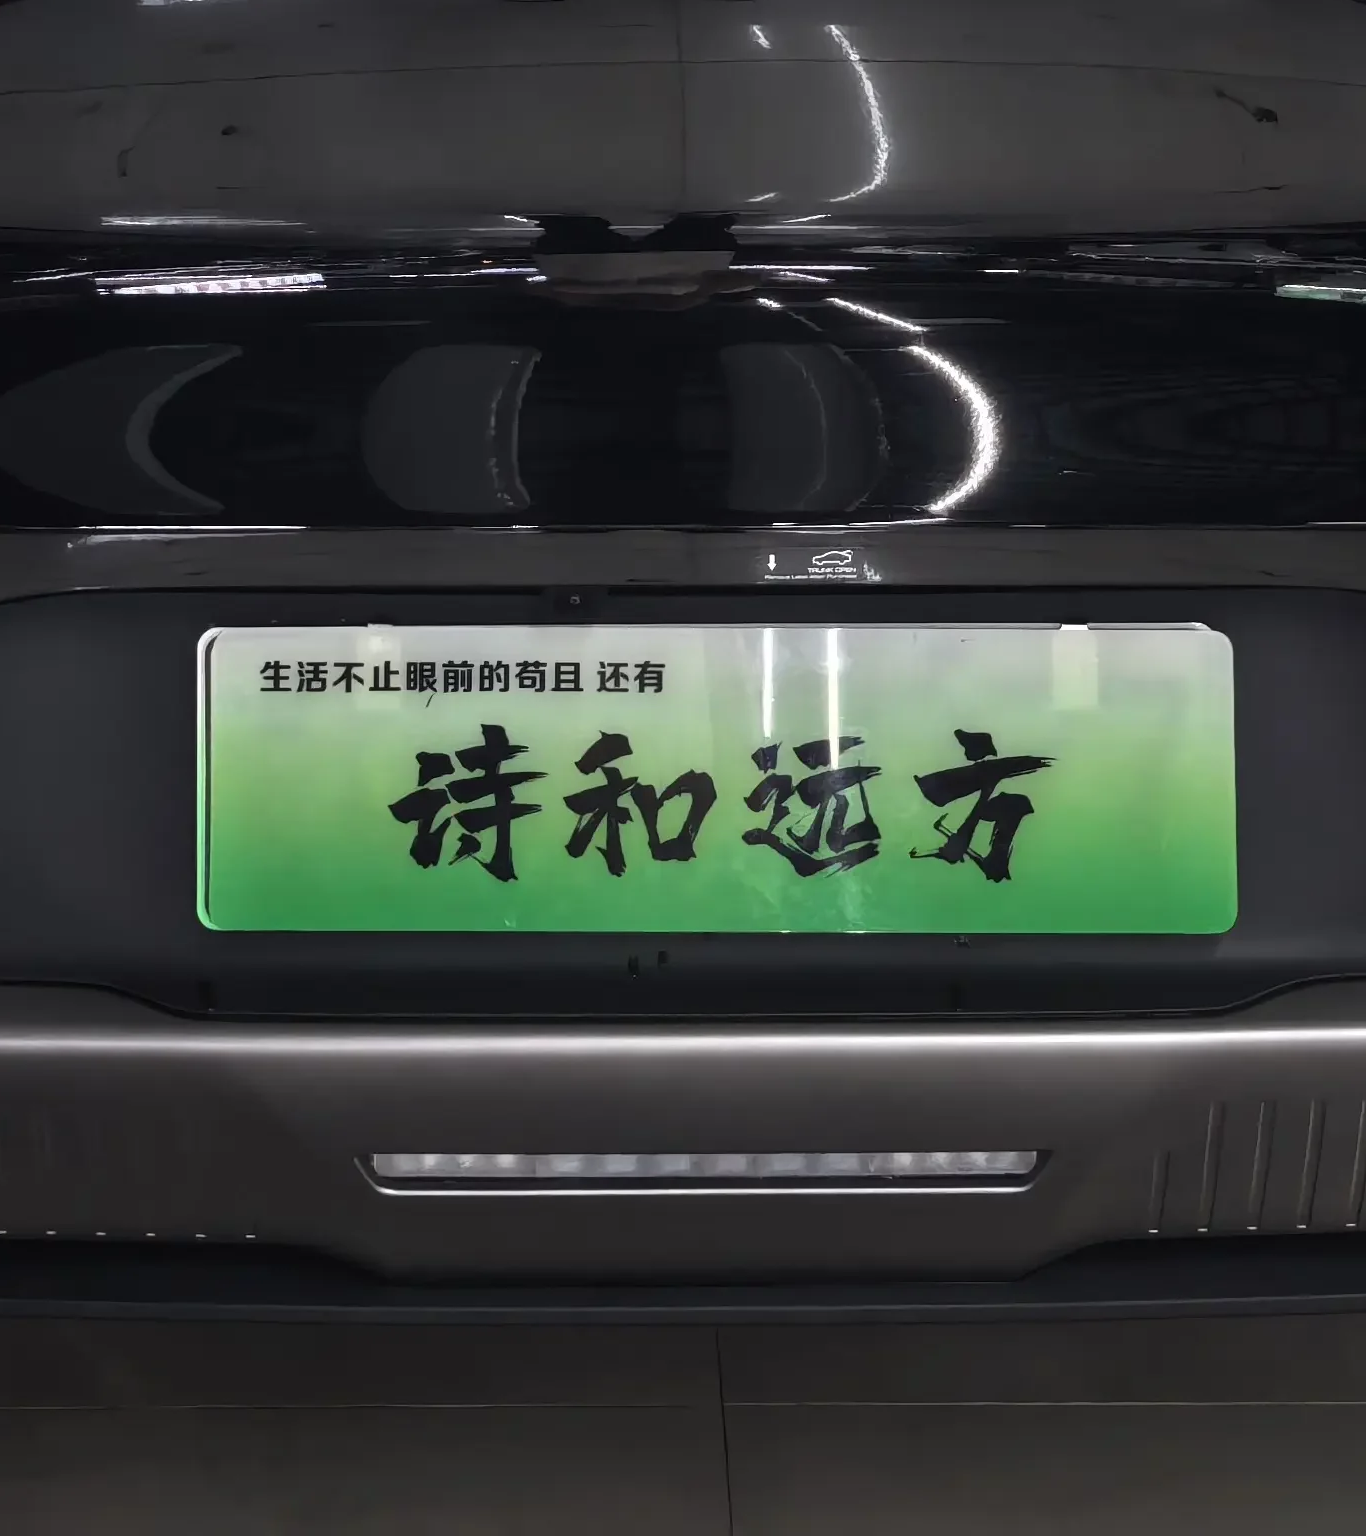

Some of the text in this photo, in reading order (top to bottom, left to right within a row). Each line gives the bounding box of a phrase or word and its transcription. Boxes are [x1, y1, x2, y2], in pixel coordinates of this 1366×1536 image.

[259, 661, 666, 693] 生活不止眼前的苟且 还有
[388, 723, 1059, 884] 诗和远方
